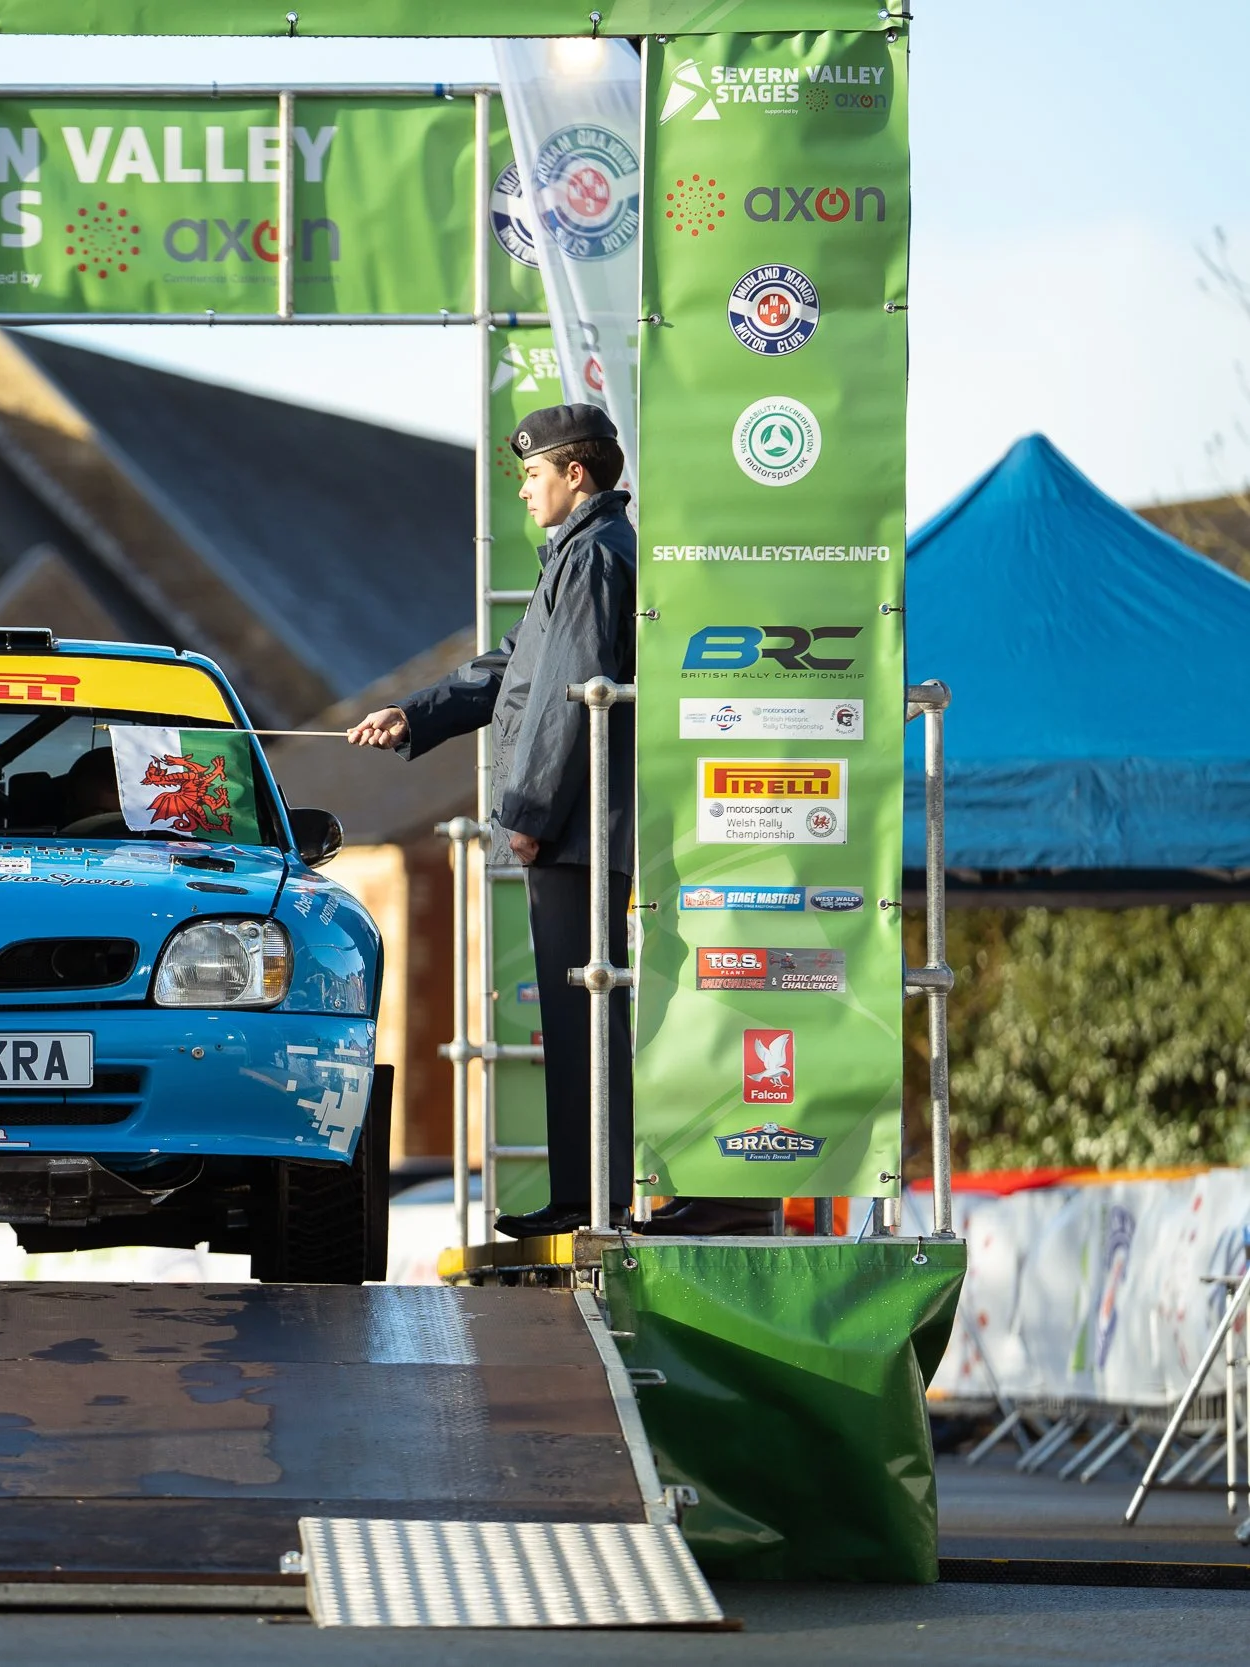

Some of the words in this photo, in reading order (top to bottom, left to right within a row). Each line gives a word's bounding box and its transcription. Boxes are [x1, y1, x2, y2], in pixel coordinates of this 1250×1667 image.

[711, 66, 799, 84] SEVERN
[806, 66, 884, 84] VALLEY
[716, 84, 800, 103] STAGES
[835, 93, 886, 108] axon
[62, 126, 339, 183] VALLEY
[744, 186, 886, 222] axon
[164, 218, 340, 262] axon
[20, 270, 42, 288] by
[736, 268, 779, 299] MIDLAND
[784, 270, 814, 304] MANOR
[735, 322, 768, 352] MOTOR
[778, 332, 805, 352] CLUB
[740, 405, 776, 454] SUSTAINABILITY
[780, 404, 814, 453] ACCREDITATION
[746, 457, 798, 480] motorsport
[652, 545, 890, 562] SEVERNVALLEYSTAGES.INFO
[682, 626, 864, 670] BRC
[775, 672, 864, 680] CHAMPIONSHIP
[710, 714, 742, 722] FUCHS
[714, 768, 832, 794] PIRELLI
[726, 805, 779, 814] motorsport
[726, 818, 756, 828] Welsh
[759, 818, 782, 829] Rally
[726, 830, 794, 840] Championship
[726, 892, 755, 904] STAGE
[756, 893, 801, 905] MASTERS
[706, 952, 762, 969] T.C.S.
[771, 977, 777, 986] &
[782, 974, 810, 982] CELTIC
[812, 974, 838, 982] MICRA
[782, 982, 838, 990] CHALLENGE
[751, 1090, 788, 1100] Falcon
[726, 1136, 814, 1151] BRACE'S
